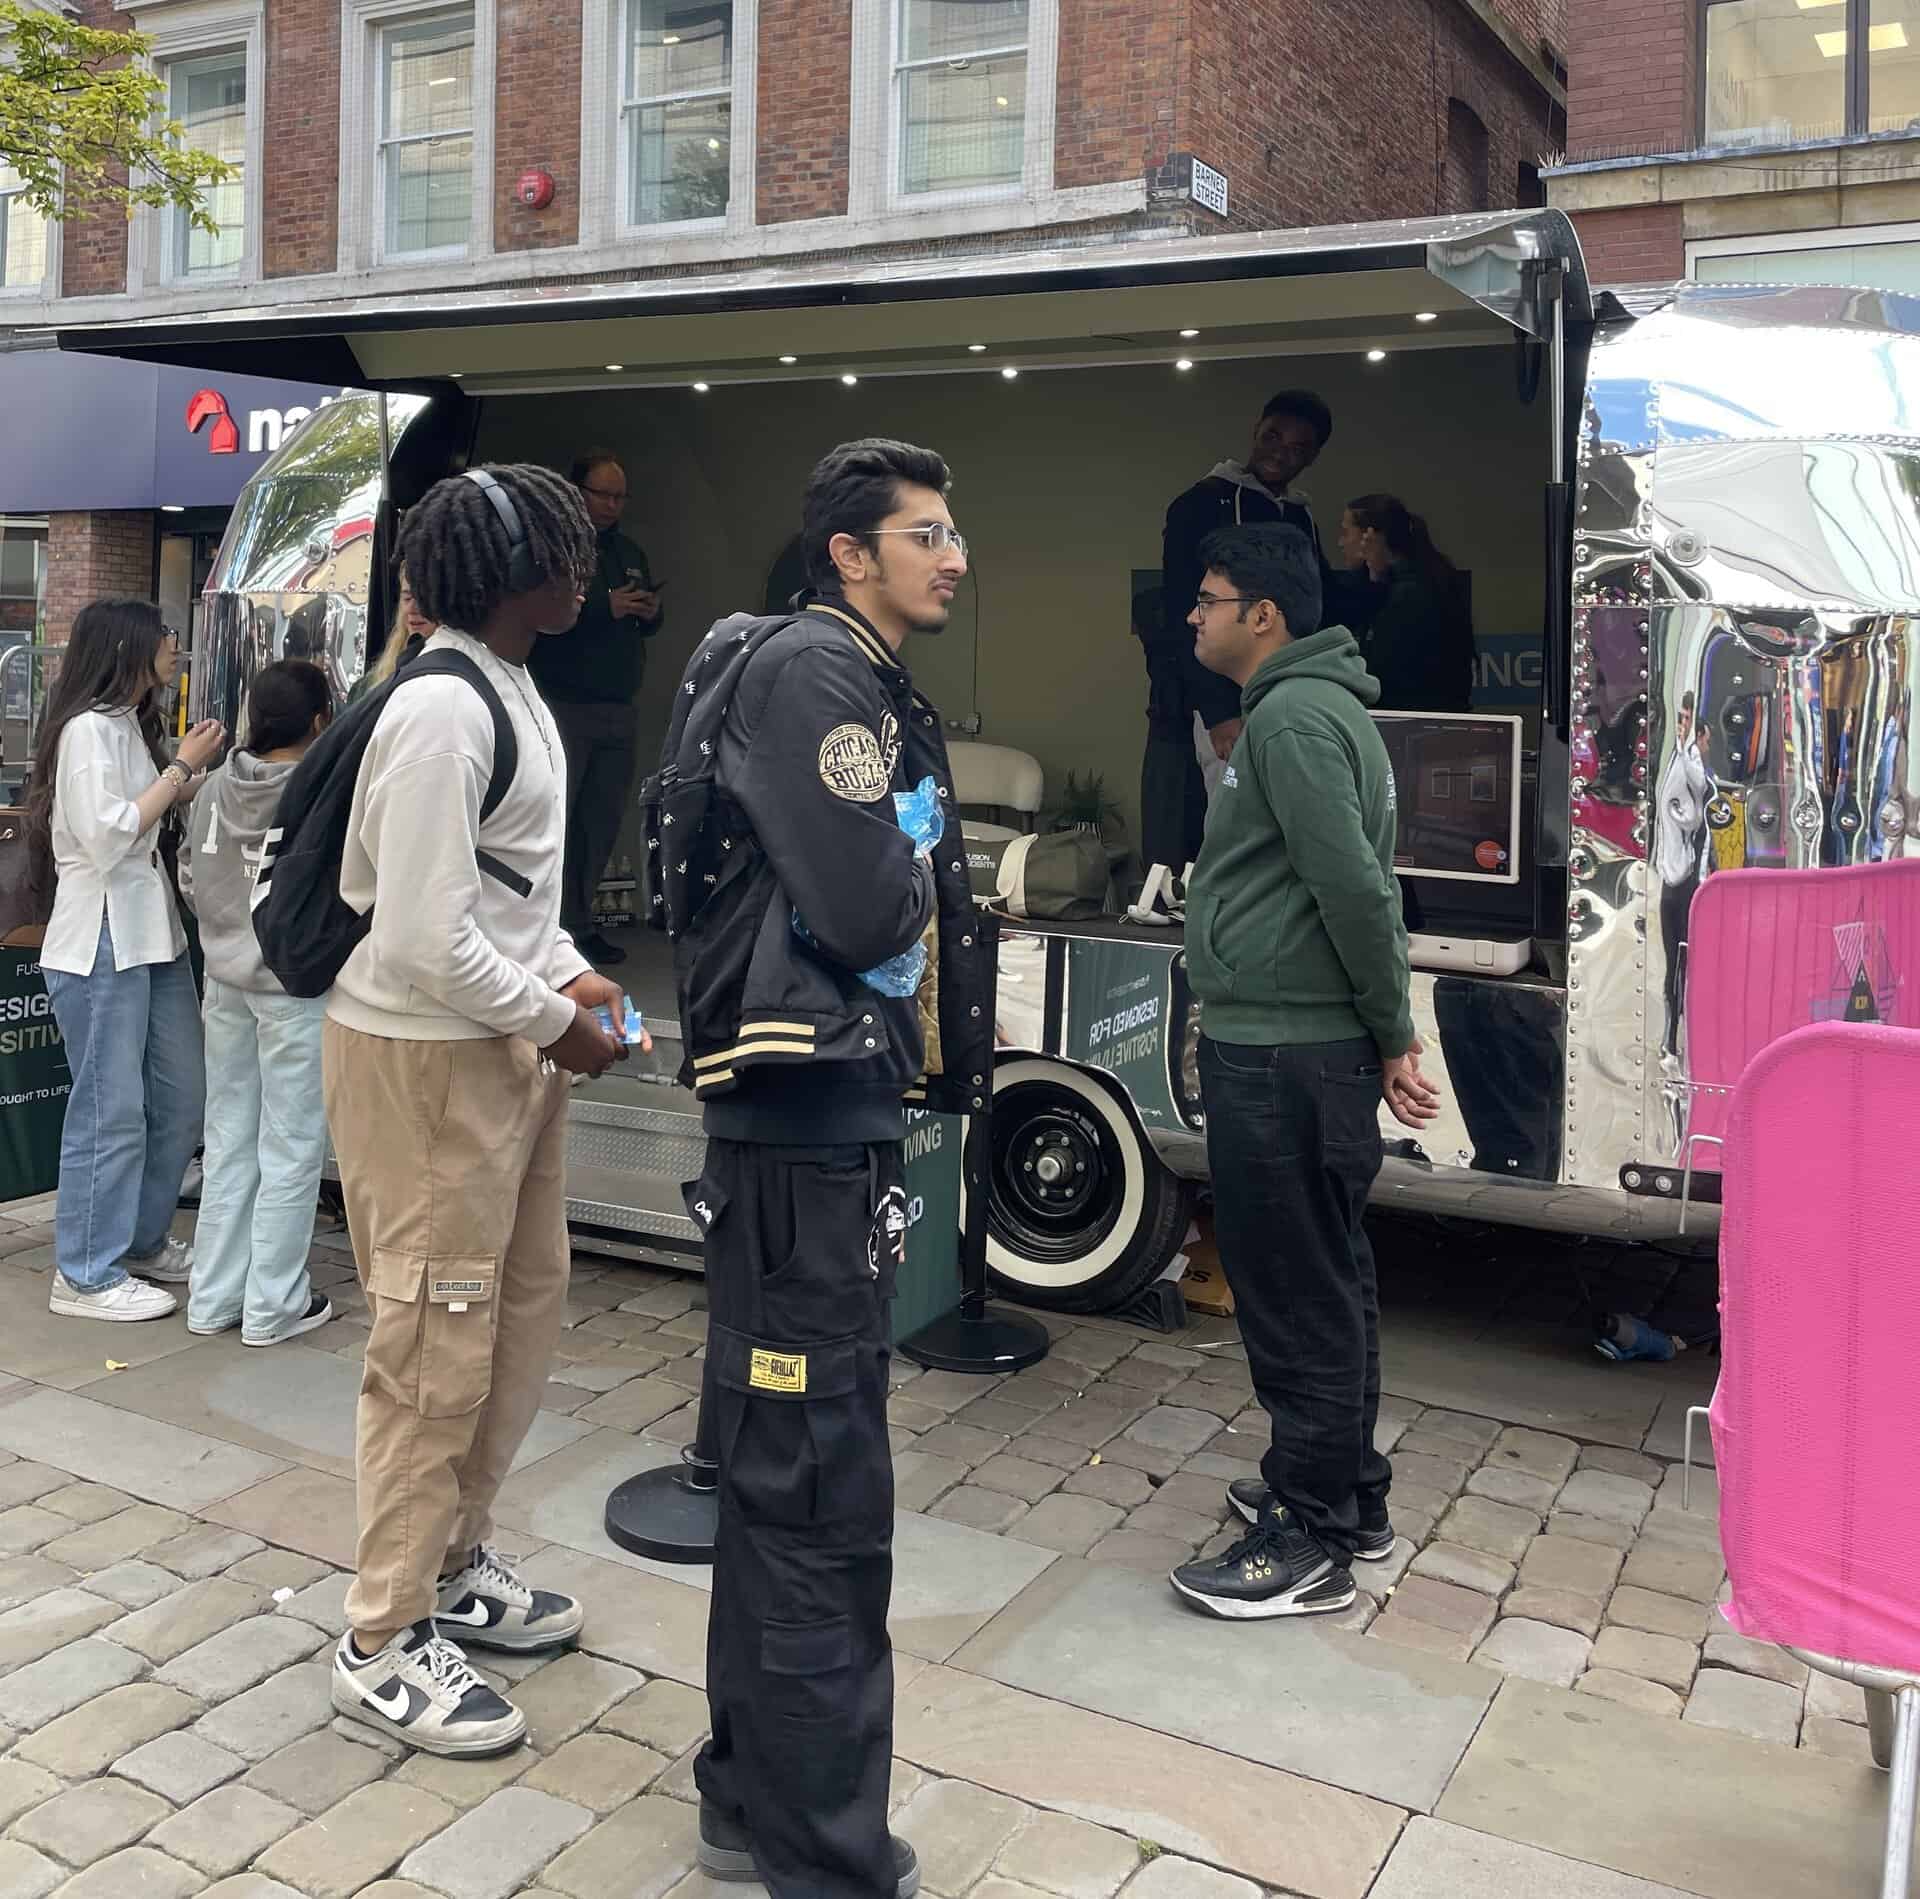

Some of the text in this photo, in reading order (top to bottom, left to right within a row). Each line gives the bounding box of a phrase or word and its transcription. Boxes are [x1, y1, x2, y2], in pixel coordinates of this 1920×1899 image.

[1196, 163, 1225, 194] BARNES
[1196, 182, 1224, 210] STREET
[831, 763, 884, 789] BULLS
[244, 865, 258, 878] NE
[16, 962, 42, 976] FUS
[0, 1024, 63, 1054] SITIV
[0, 1085, 71, 1105] OUGHT TO LIFE
[903, 1122, 942, 1165] IVING
